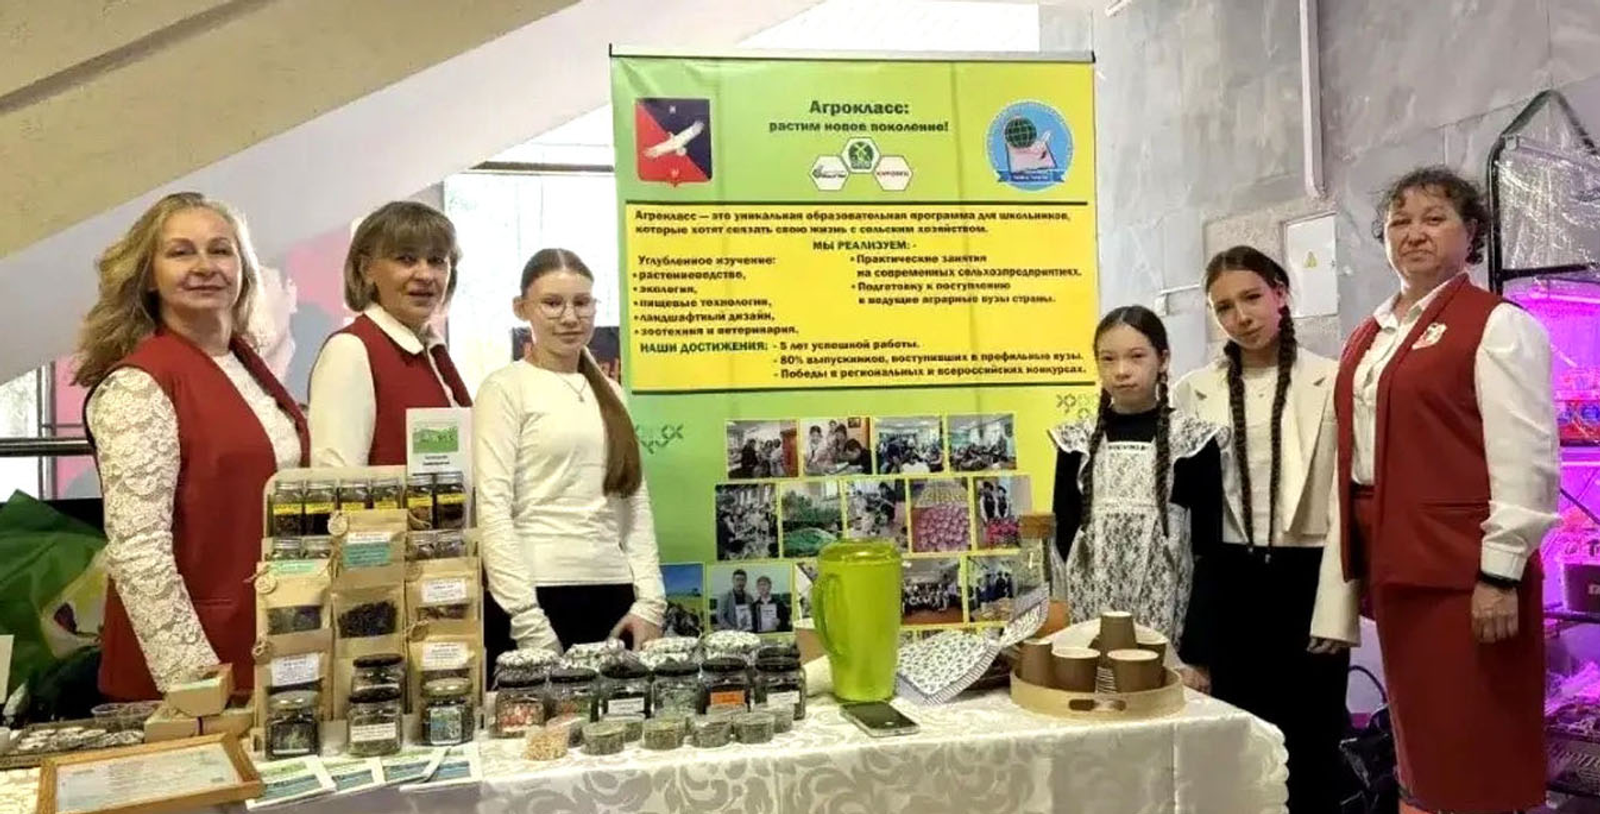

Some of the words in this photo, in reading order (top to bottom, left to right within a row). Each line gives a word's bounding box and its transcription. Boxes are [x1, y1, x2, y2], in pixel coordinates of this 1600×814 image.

[809, 99, 909, 117] Агрокласс:
[769, 121, 820, 133] растим
[824, 121, 867, 132] новое
[870, 120, 948, 132] поколение!
[635, 209, 697, 222] Агрокласс
[712, 211, 731, 221] это
[734, 211, 803, 223] уникальная
[806, 210, 907, 222] образовательная
[910, 211, 976, 223] программа
[977, 211, 997, 222] для
[999, 211, 1070, 222] школьников,
[635, 225, 688, 237] которые
[691, 225, 724, 234] хотят
[725, 225, 773, 235] связать
[775, 225, 808, 234] свою
[810, 225, 847, 234] жизнь
[850, 225, 856, 234] с
[859, 224, 914, 234] сельским
[917, 222, 988, 233] хозяйством.
[813, 240, 834, 251] МЫ
[837, 239, 910, 251] РЕАЛИЗУЕМ:
[638, 254, 713, 268] Углубленное
[715, 256, 776, 267] изучение:
[856, 253, 939, 266] Практические
[941, 253, 987, 263] занятия
[857, 269, 872, 278] на
[874, 268, 955, 280] современных
[639, 285, 698, 295] экология,
[858, 281, 923, 293] Подготовку
[926, 282, 933, 291] к
[936, 281, 1011, 292] поступлению
[639, 298, 698, 310] пищевые
[700, 298, 772, 308] технологии,
[868, 296, 919, 307] ведущие
[922, 295, 978, 306] аграрные
[981, 294, 1010, 305] вузы
[1012, 294, 1055, 305] страны.
[640, 311, 726, 324] ландшафтный
[641, 326, 704, 337] зоотехния
[706, 327, 714, 336] и
[640, 341, 677, 353] НАШИ
[680, 340, 768, 354] ДОСТИЖЕНИЯ:
[780, 340, 787, 350] 5
[790, 341, 808, 350] лет
[811, 338, 870, 352] успешной
[873, 338, 920, 350] работы.
[780, 354, 804, 365] 80%
[806, 355, 889, 367] выпускников,
[891, 353, 968, 365] поступивших
[971, 352, 978, 362] в
[980, 351, 1051, 365] профильные
[1053, 352, 1083, 362] вузы.
[781, 367, 827, 380] Победы
[830, 369, 838, 378] в
[840, 366, 924, 379] региональных
[927, 366, 935, 376] и
[937, 365, 1023, 377] всероссийских
[1026, 365, 1086, 376] конкурсах.
